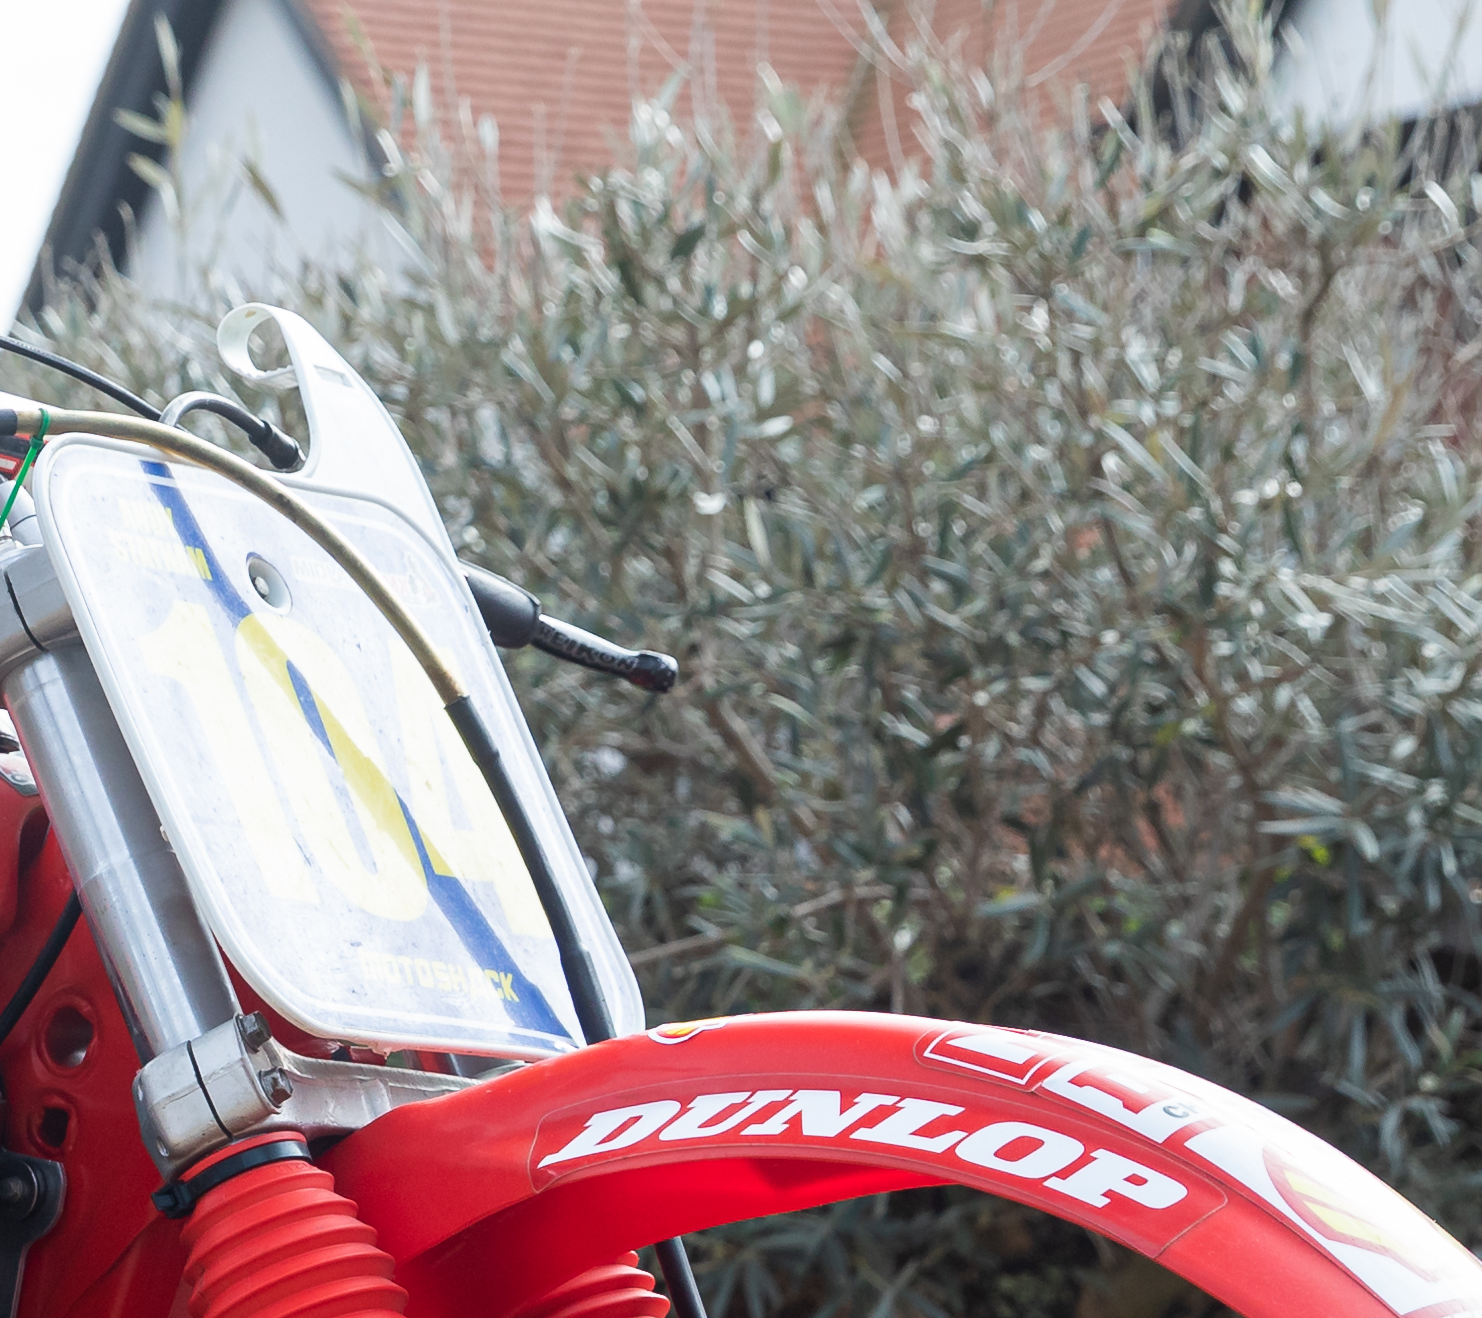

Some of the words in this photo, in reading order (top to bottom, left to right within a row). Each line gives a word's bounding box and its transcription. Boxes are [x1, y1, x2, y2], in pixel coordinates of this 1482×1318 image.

[138, 598, 561, 939] 104
[360, 948, 521, 1003] MOTOSHACK
[537, 1089, 1189, 1211] DUNLOP
